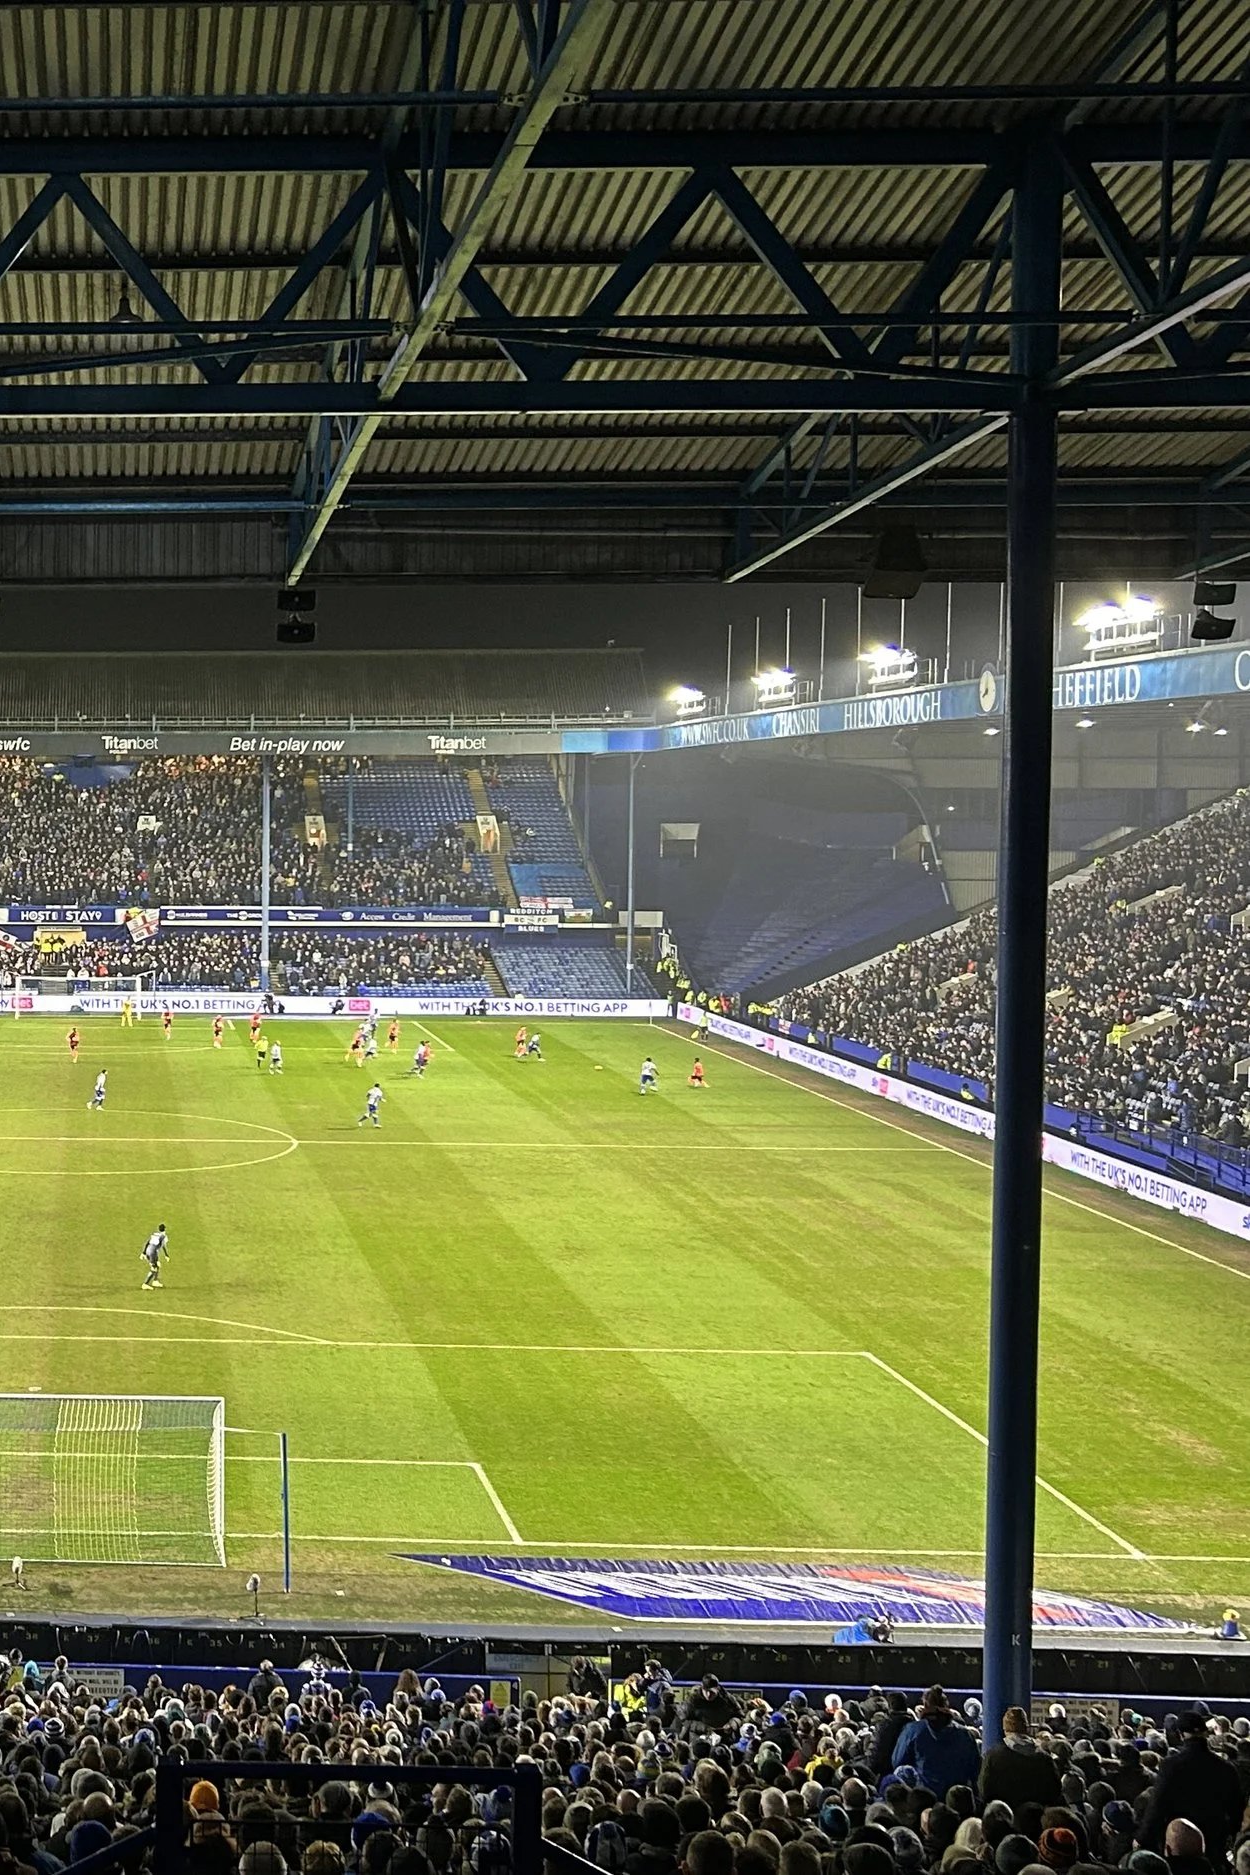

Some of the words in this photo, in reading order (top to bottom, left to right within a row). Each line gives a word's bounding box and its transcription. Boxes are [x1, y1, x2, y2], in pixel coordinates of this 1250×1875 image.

[1052, 664, 1141, 708] HEFFIELD
[844, 691, 942, 730] HILLSBOROUGH
[772, 708, 820, 737] CHANSIRI
[101, 736, 159, 750] Titanbet
[230, 737, 256, 751] Bet
[259, 737, 309, 754] in-play
[313, 740, 345, 751] now
[427, 736, 487, 750] Titanbet
[21, 911, 51, 921] HOST
[65, 911, 96, 921] STAY
[360, 912, 385, 921] Access
[423, 912, 473, 922] Management
[80, 999, 111, 1009] WITH
[140, 1000, 169, 1009] UK'S
[172, 1000, 199, 1009] NO.1
[204, 1000, 255, 1010] BETTING
[419, 1001, 450, 1011] WITH
[514, 1002, 543, 1012] NO.1
[547, 1002, 600, 1013] BETTING
[603, 1003, 628, 1013] APP
[1070, 1150, 1091, 1172] WITH
[1091, 1157, 1106, 1178] THE
[1107, 1163, 1126, 1183] UK'S
[1128, 1172, 1148, 1193] NO.1
[1150, 1179, 1187, 1208] BETTING
[1188, 1195, 1207, 1215] APP
[1011, 1635, 1022, 1646] K
